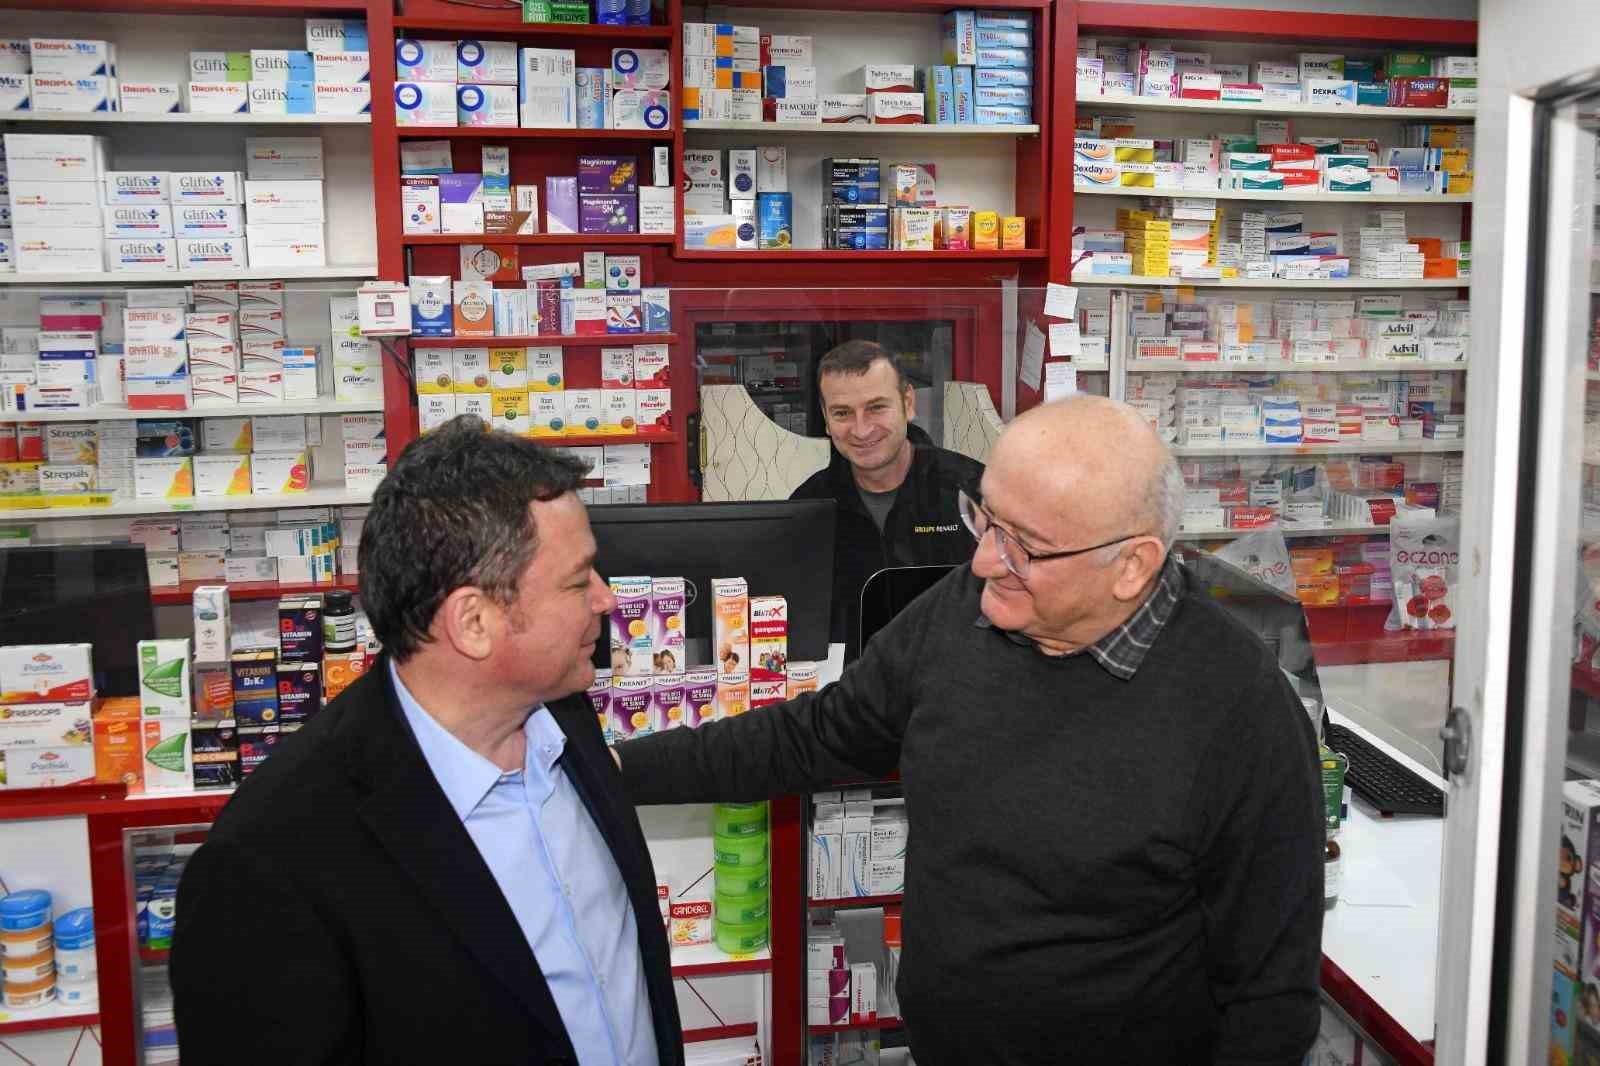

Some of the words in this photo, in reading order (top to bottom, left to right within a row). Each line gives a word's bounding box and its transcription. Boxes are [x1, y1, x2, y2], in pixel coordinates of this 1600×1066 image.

[1385, 323, 1414, 335] Advil
[1391, 343, 1419, 354] Advil
[50, 428, 96, 439] Strepsils
[42, 468, 89, 480] Strepsils
[672, 905, 709, 916] CANDEREL
